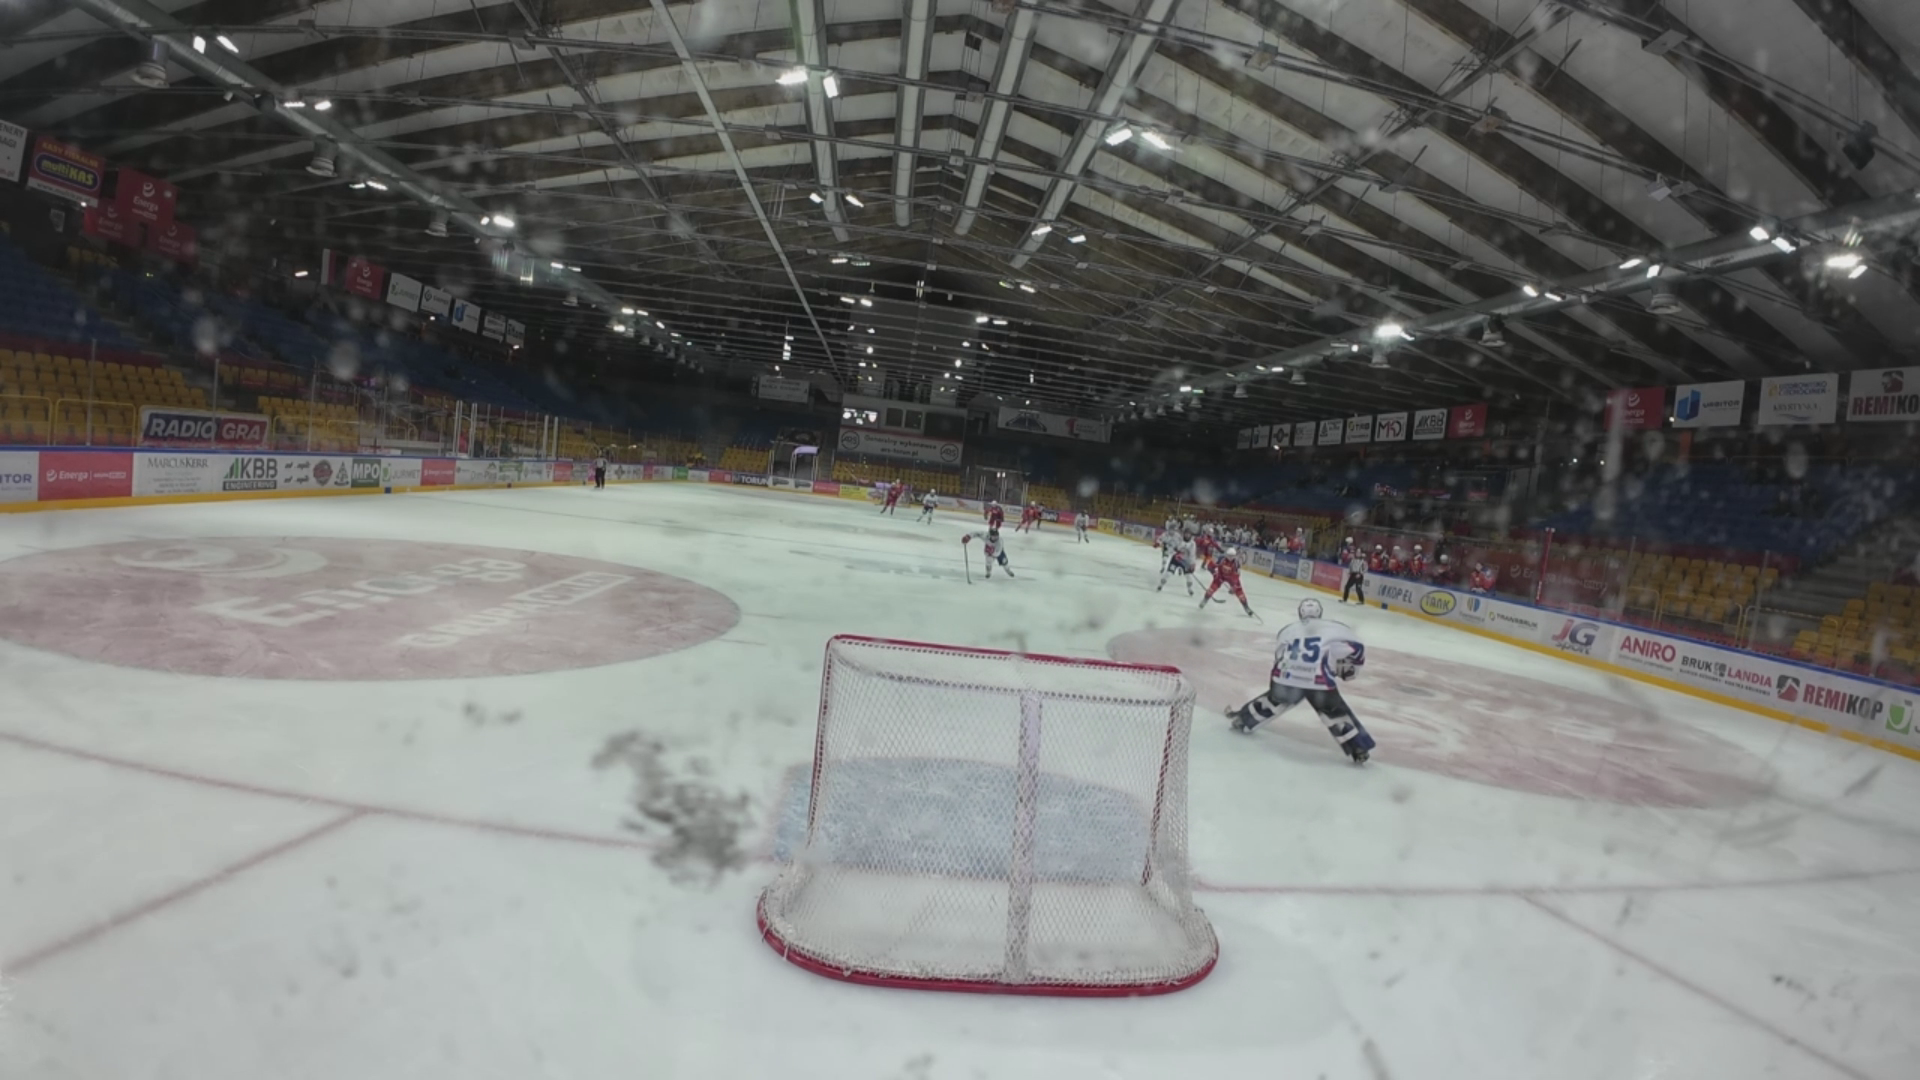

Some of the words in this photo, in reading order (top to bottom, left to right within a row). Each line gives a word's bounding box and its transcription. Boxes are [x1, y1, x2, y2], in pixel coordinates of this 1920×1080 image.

[42, 160, 94, 186] multiKAS
[150, 418, 215, 439] RADIO
[222, 423, 261, 441] GRA
[59, 470, 89, 482] Energa
[352, 462, 380, 479] MPO
[1551, 618, 1600, 647] JG
[1287, 637, 1322, 663] 45
[1620, 635, 1677, 663] ANIRO
[1681, 656, 1714, 674] BRUK
[1727, 667, 1773, 688] LANDIA
[1803, 683, 1884, 721] REMIKOP
